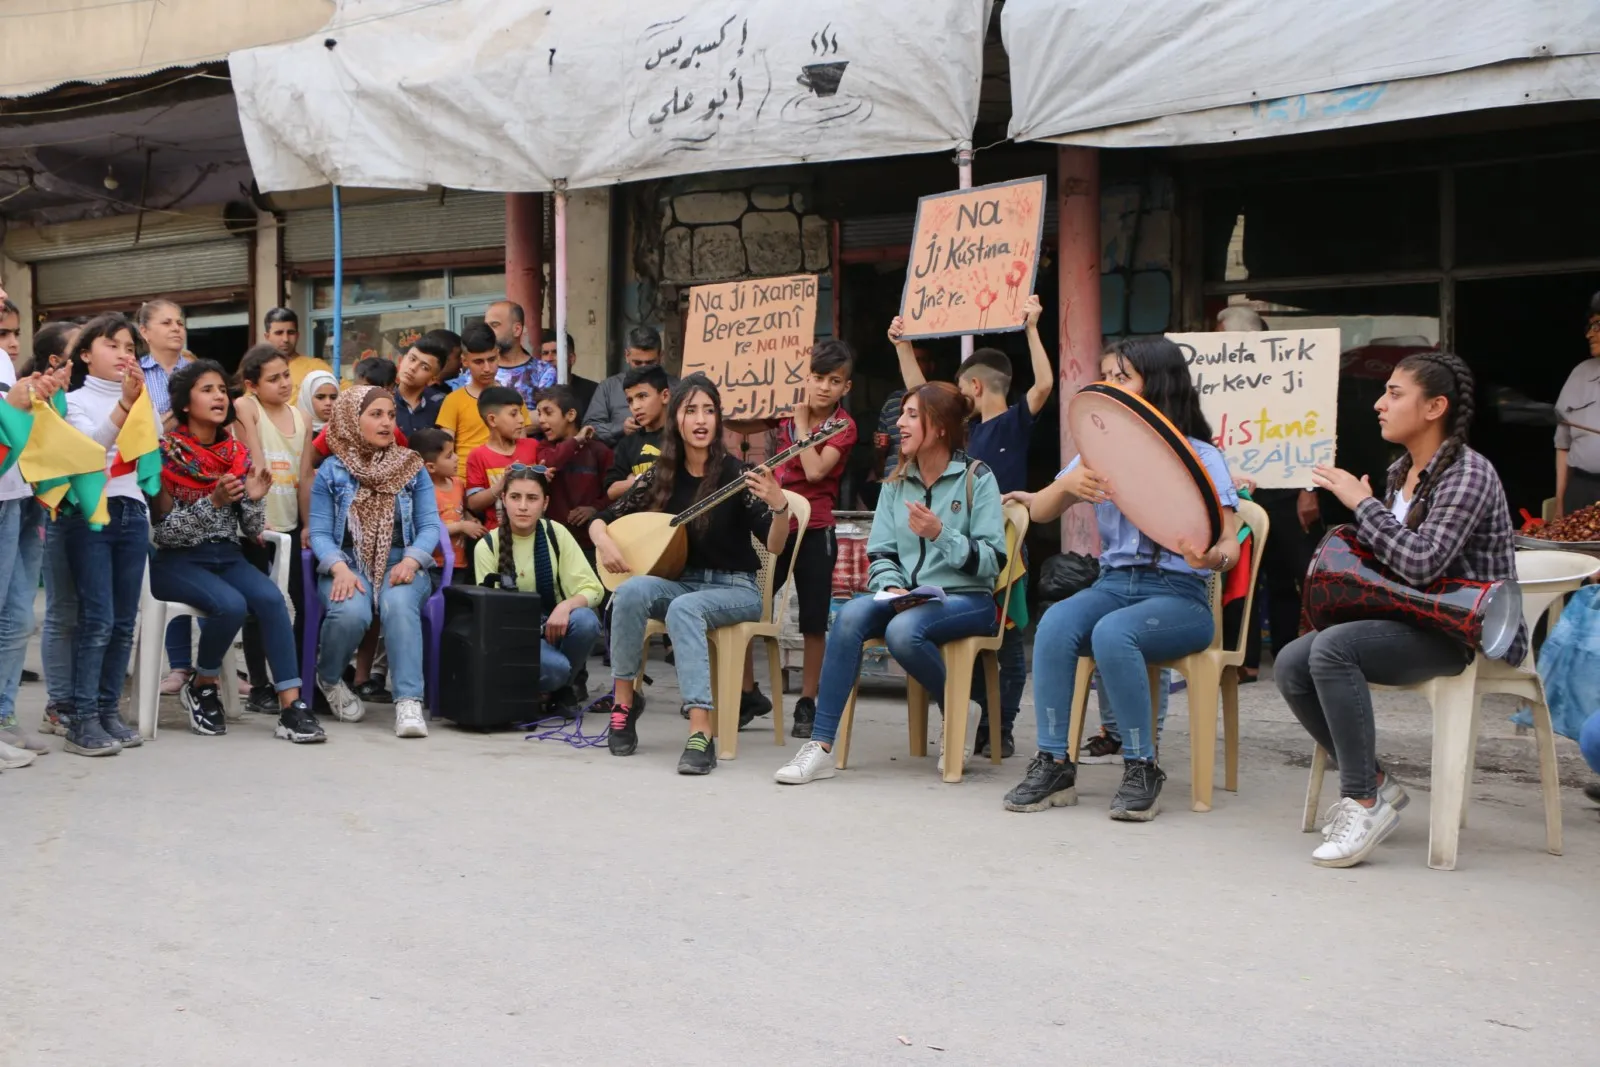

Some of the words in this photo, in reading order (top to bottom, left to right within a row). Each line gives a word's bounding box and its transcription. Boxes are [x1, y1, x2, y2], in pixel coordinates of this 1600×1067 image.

[956, 199, 1003, 231] Na
[695, 291, 723, 312] Na
[702, 305, 804, 343] Berezanî
[757, 338, 777, 354] Na
[781, 335, 799, 349] Na
[1178, 342, 1256, 366] Dewleta
[1260, 337, 1316, 362] Tirk
[784, 361, 804, 384] لا
